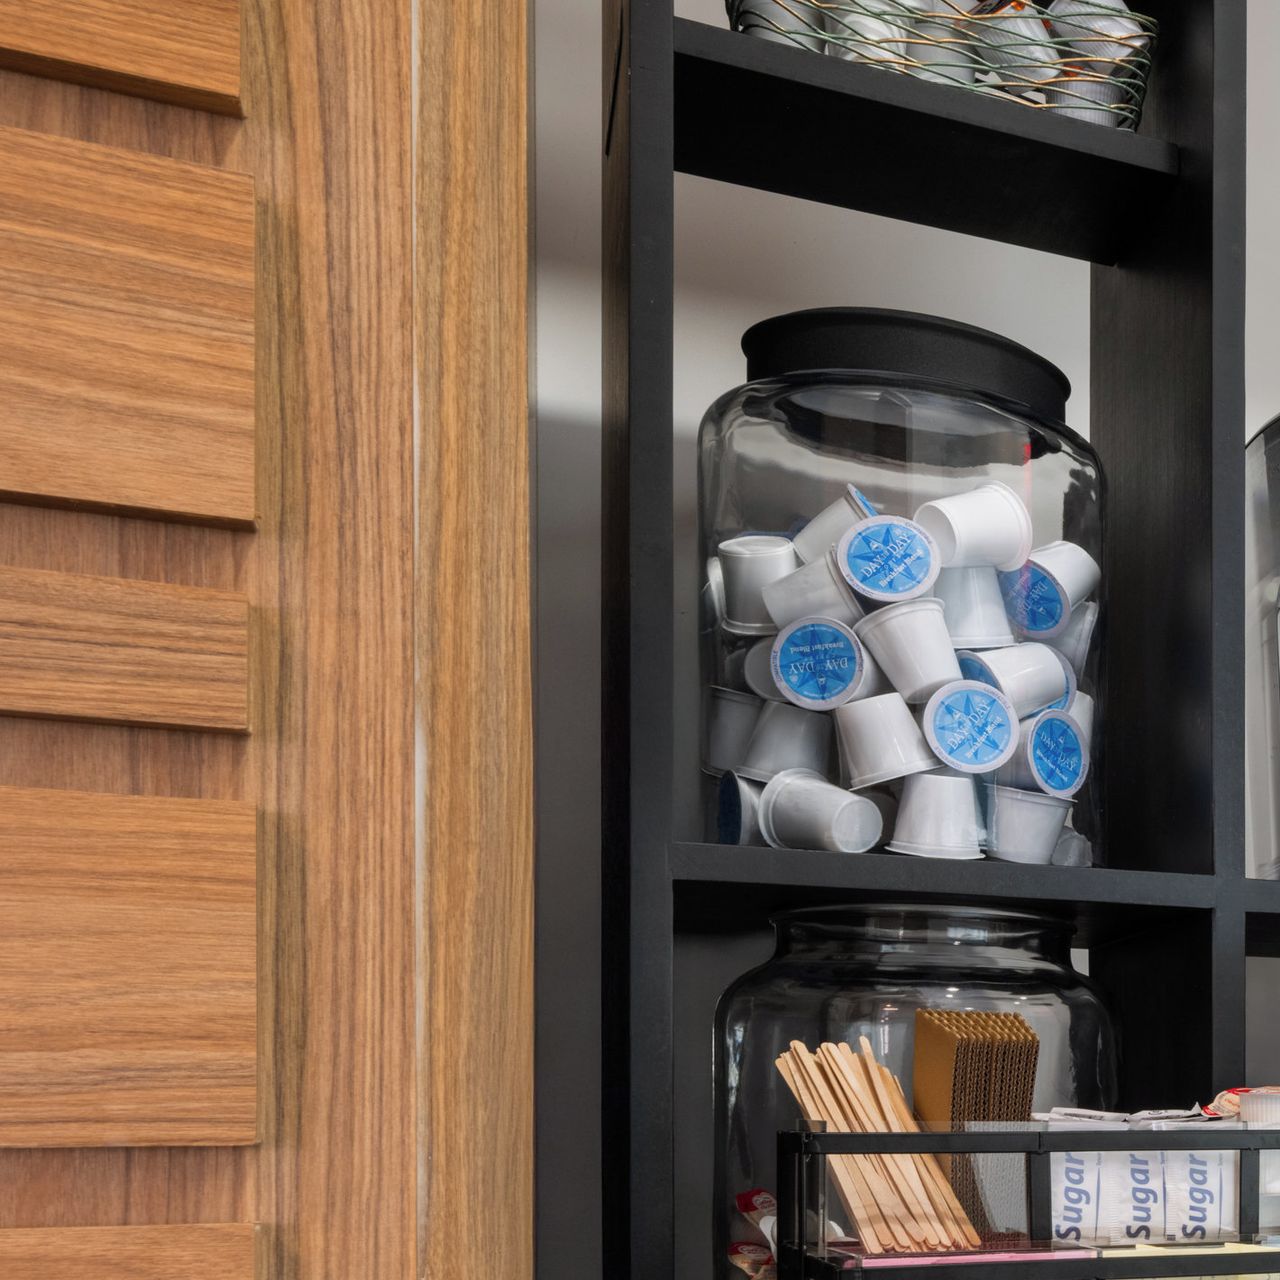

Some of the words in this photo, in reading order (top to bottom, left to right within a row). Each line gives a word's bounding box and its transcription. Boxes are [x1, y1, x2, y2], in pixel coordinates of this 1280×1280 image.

[860, 554, 884, 577] DAY
[887, 533, 912, 556] DAY
[789, 661, 816, 675] DAY
[825, 657, 849, 671] DAY
[947, 726, 971, 751] DAY
[967, 701, 991, 724] DAY
[1055, 1152, 1091, 1241] Sugar
[1126, 1153, 1158, 1240] Sugar
[1181, 1153, 1215, 1240] Sugar
